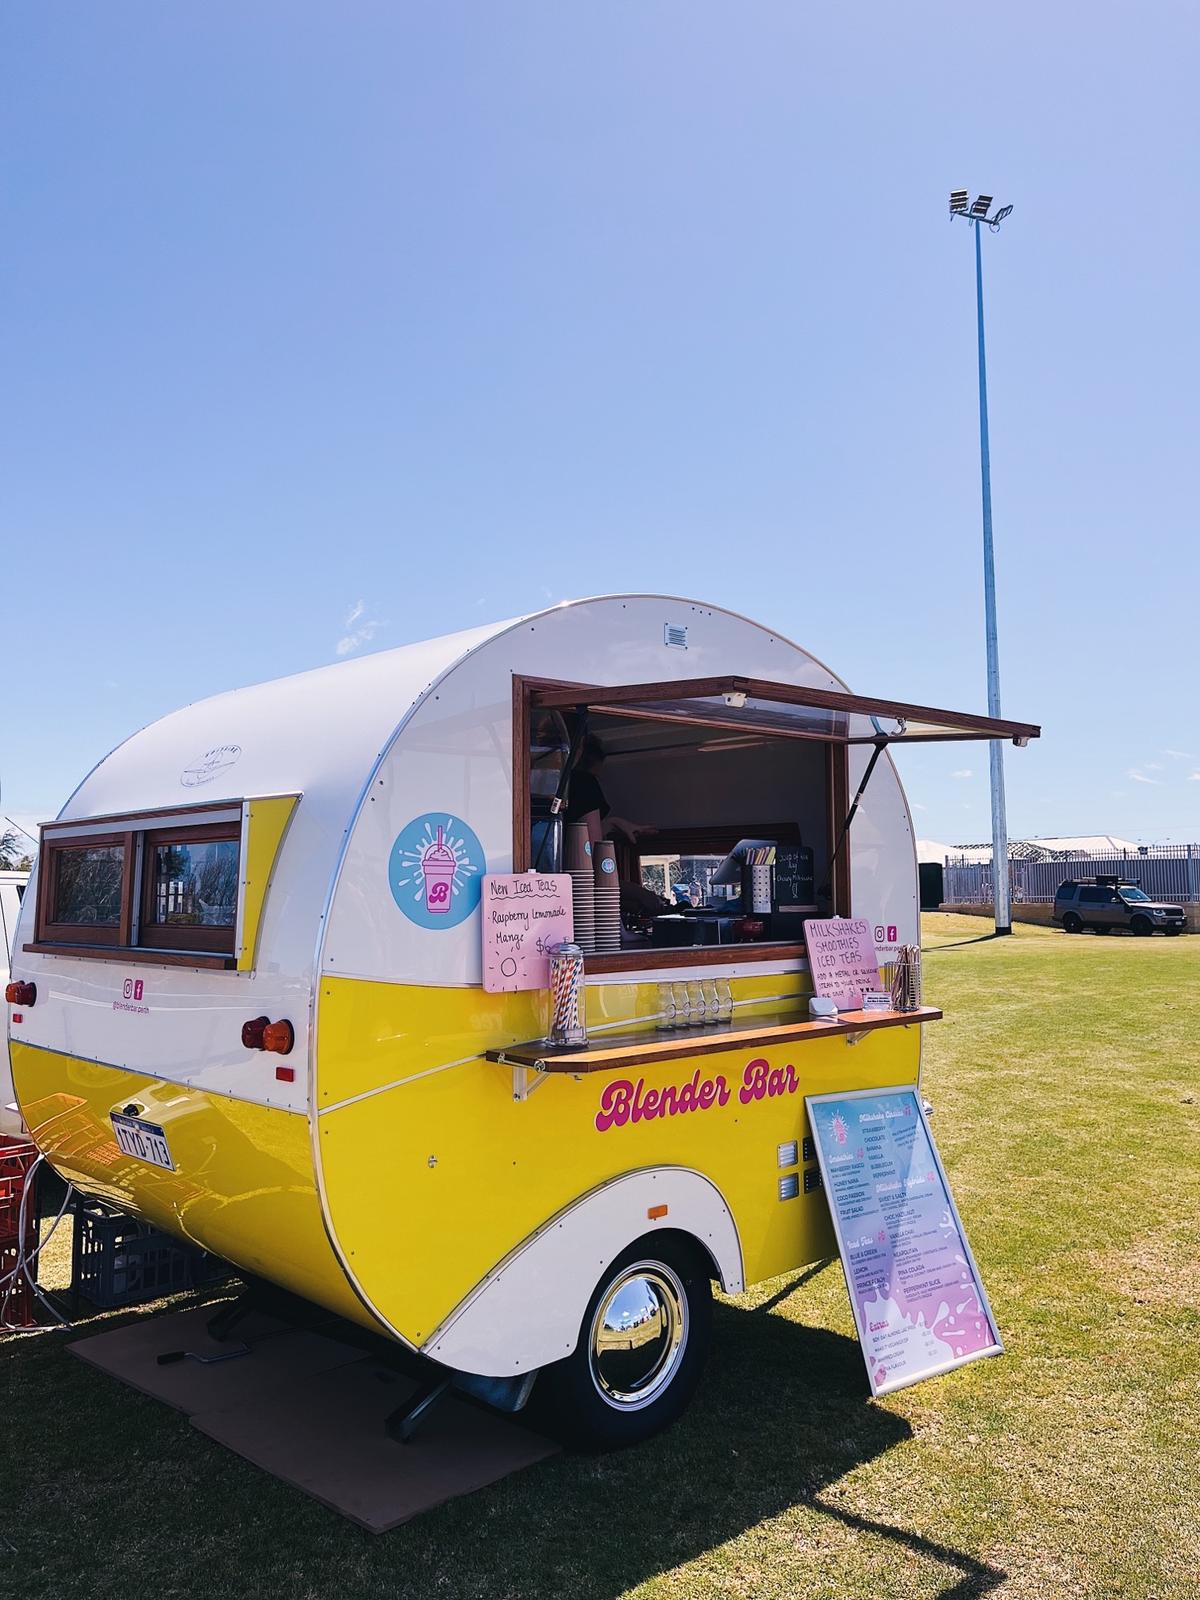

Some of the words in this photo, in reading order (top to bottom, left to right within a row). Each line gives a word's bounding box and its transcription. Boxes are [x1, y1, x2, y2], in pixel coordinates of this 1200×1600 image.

[429, 882, 449, 904] B
[491, 880, 508, 895] New
[513, 879, 533, 894] Iced
[492, 910, 529, 931] Raspberry
[810, 921, 867, 937] MILKSHAKES
[815, 937, 859, 953] SMOOTHIES
[817, 954, 836, 968] ICED
[839, 950, 862, 964] TEAS
[595, 1069, 731, 1132] Blender
[739, 1058, 800, 1105] Bar
